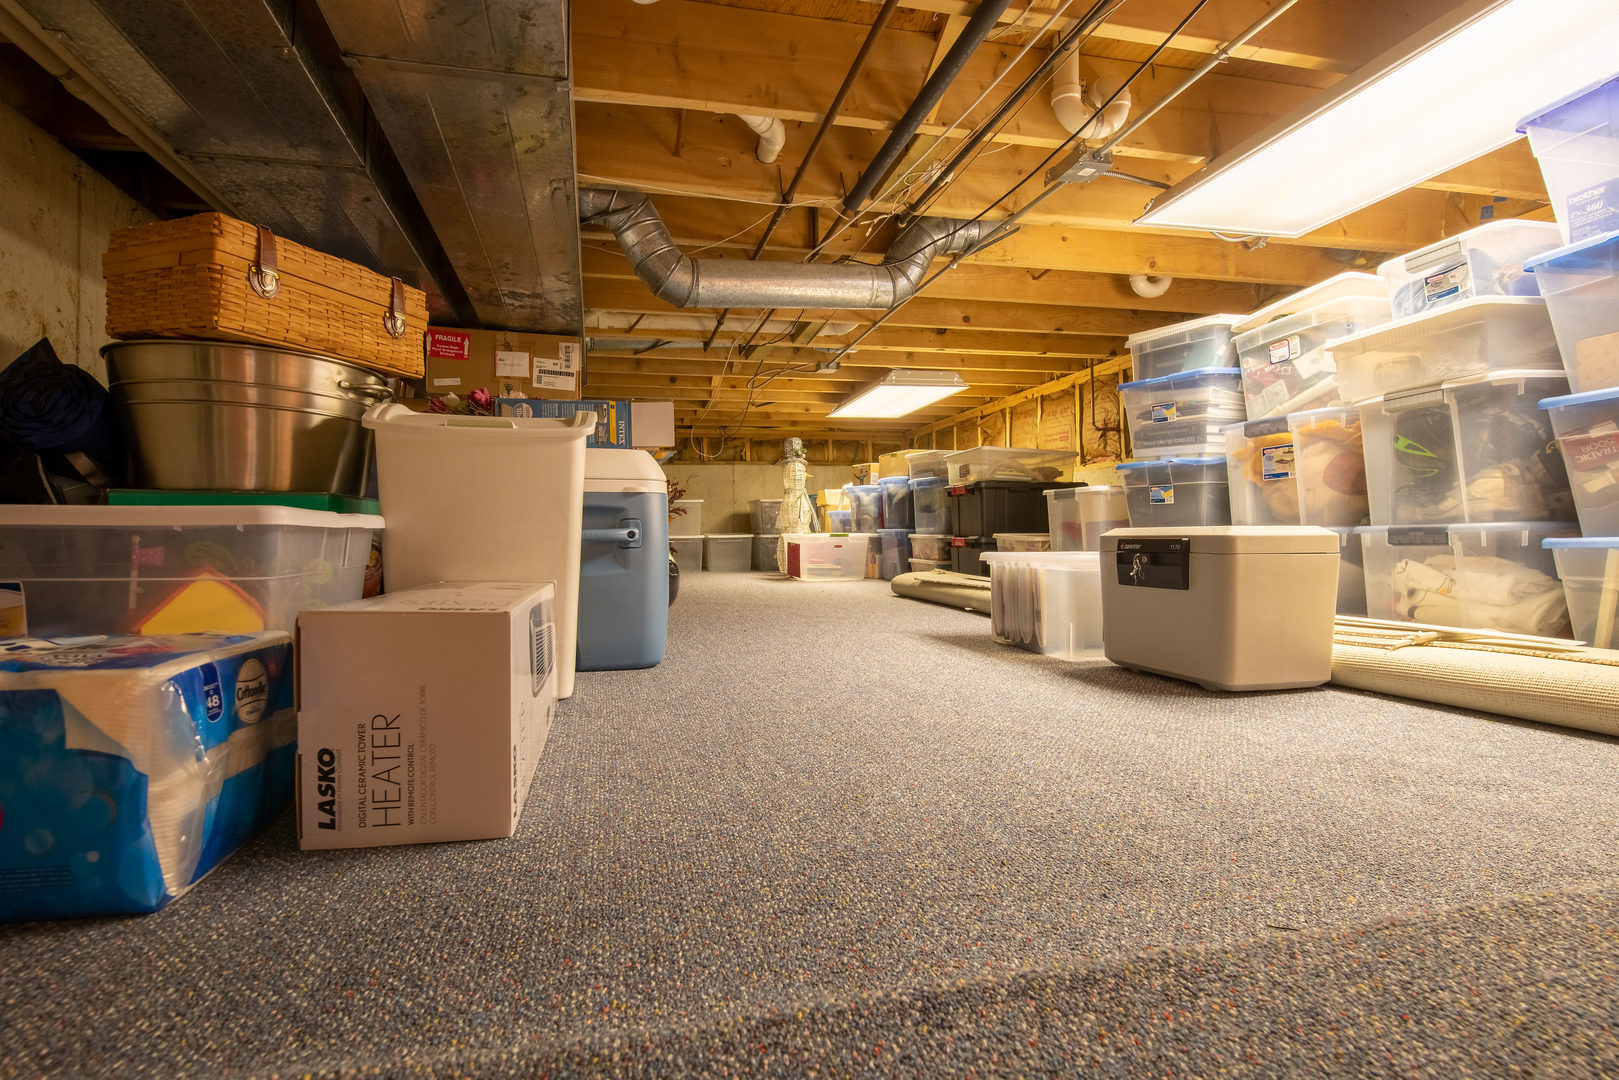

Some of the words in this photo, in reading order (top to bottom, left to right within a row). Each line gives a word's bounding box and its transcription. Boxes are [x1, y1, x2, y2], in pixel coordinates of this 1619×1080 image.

[435, 334, 462, 343] FRAGILE
[207, 695, 220, 708] 48
[357, 723, 366, 753] TOWER
[357, 755, 366, 795] CERAMIC
[371, 713, 401, 828] HEATER
[407, 743, 415, 778] CONTROL
[317, 747, 336, 830] LASKO
[407, 778, 415, 807] REMOTE
[358, 796, 367, 828] DIGITAL
[407, 807, 415, 826] WITH
